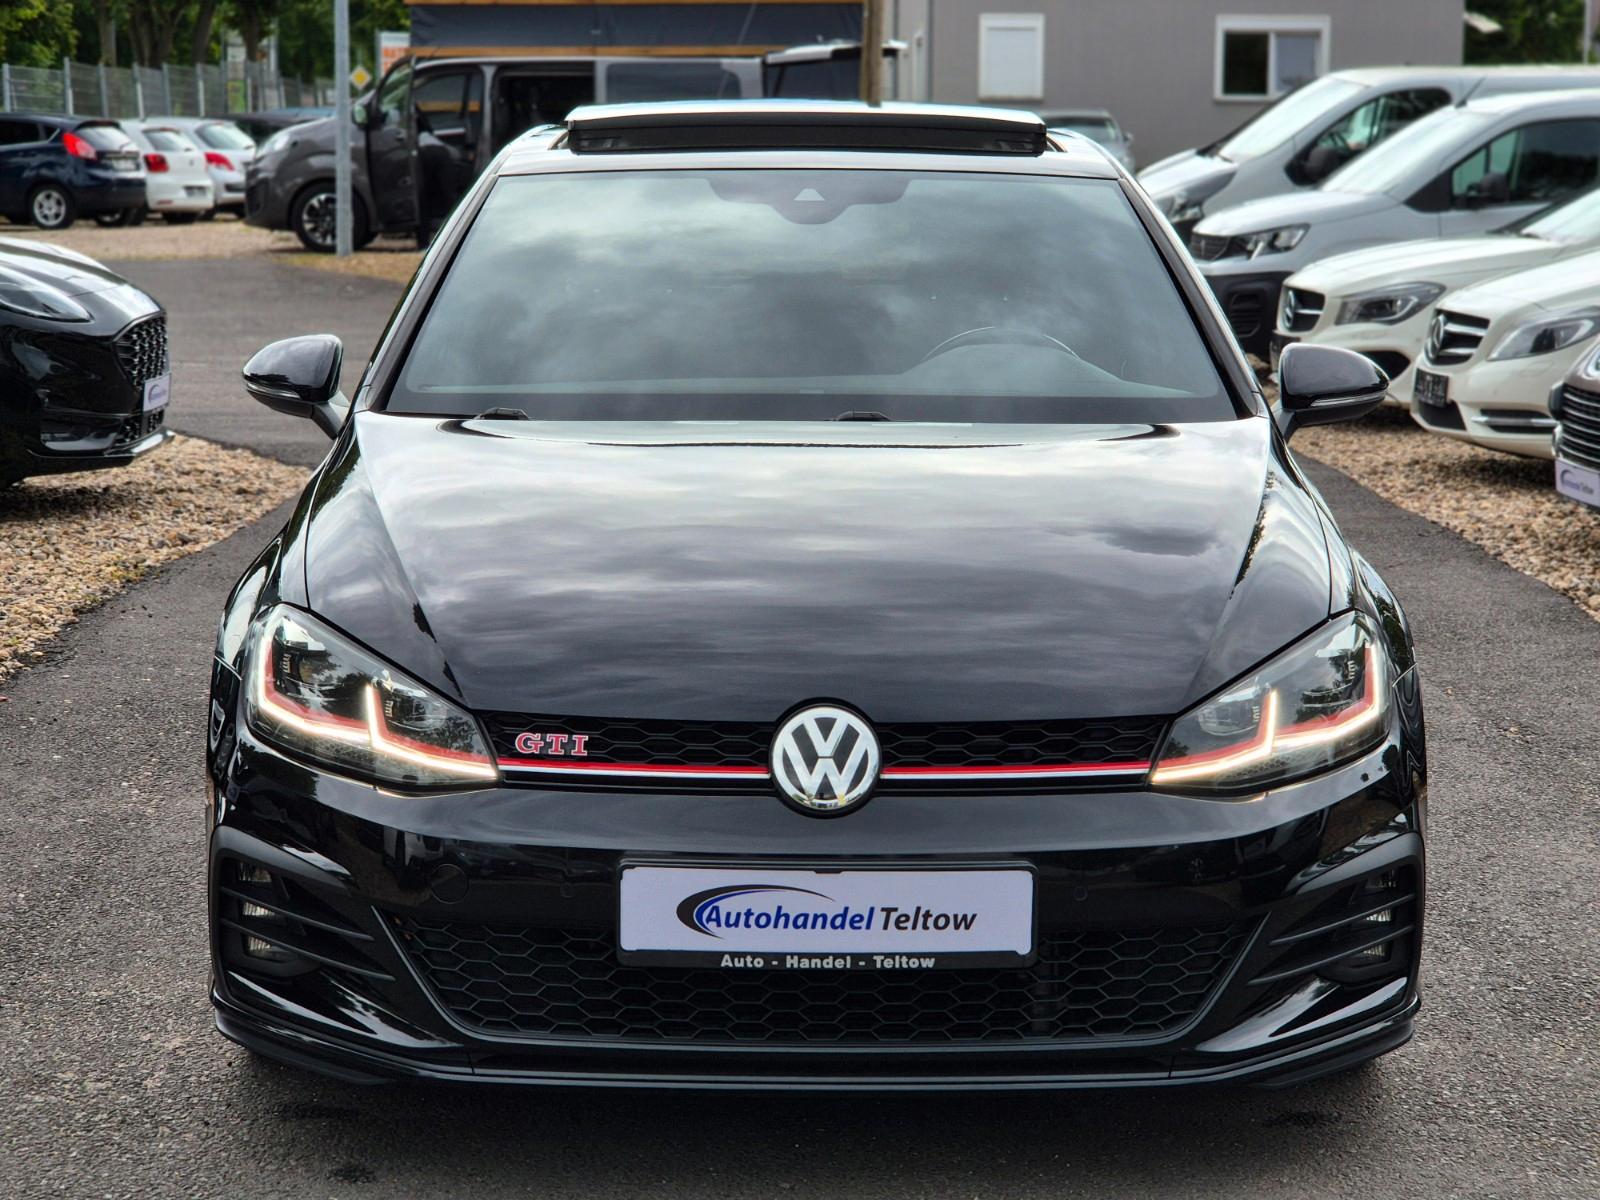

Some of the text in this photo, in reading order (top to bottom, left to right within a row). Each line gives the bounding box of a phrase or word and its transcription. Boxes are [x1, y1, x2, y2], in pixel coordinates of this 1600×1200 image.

[515, 732, 589, 756] GTI
[705, 905, 977, 930] Autohandel Teltow
[720, 954, 764, 968] Auto
[785, 955, 850, 969] Handel
[873, 955, 935, 969] Teltow
